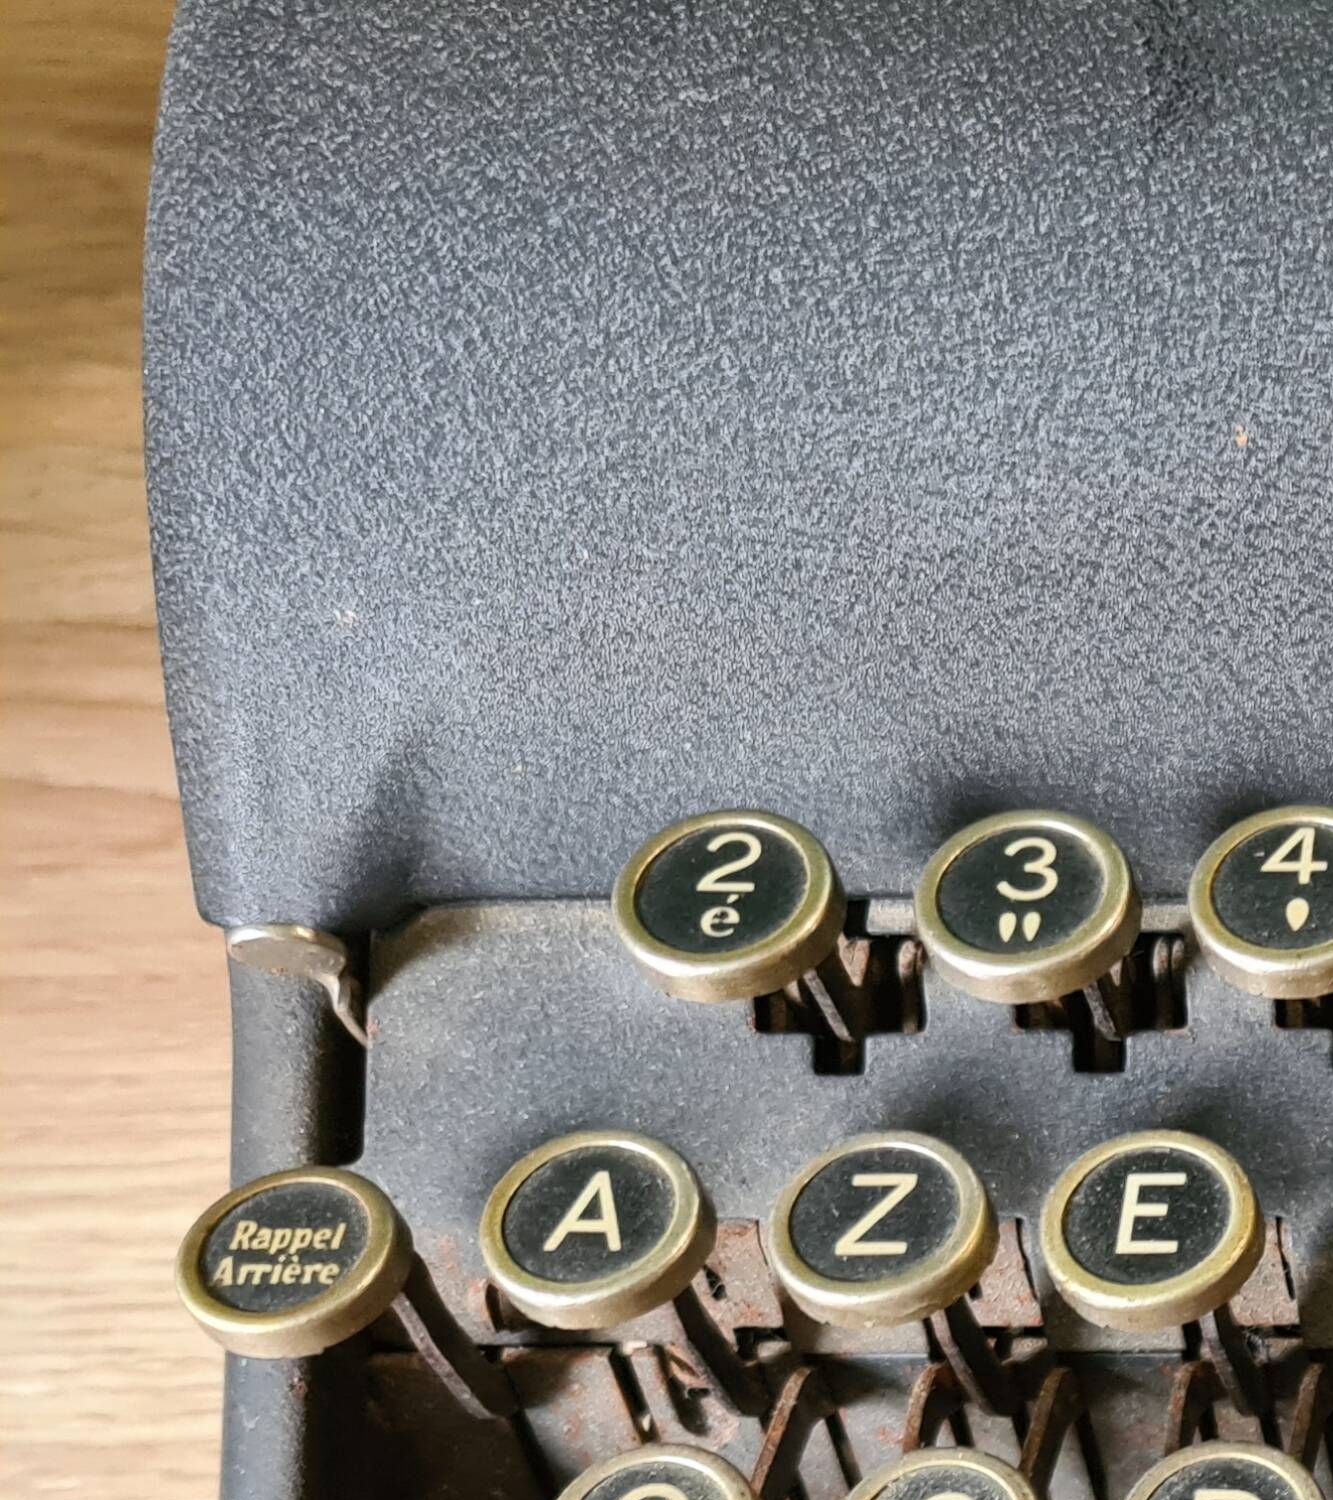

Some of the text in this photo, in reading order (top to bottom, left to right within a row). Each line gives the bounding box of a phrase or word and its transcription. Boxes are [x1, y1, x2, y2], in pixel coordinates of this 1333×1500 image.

[697, 832, 761, 892] 2
[997, 837, 1058, 900] 3
[1260, 827, 1328, 884] 4
[700, 894, 739, 937] é
[230, 1219, 346, 1254] Rappel
[543, 1171, 621, 1251] A
[835, 1173, 917, 1260] Z
[1115, 1173, 1186, 1254] E
[213, 1254, 341, 1287] Arrière
